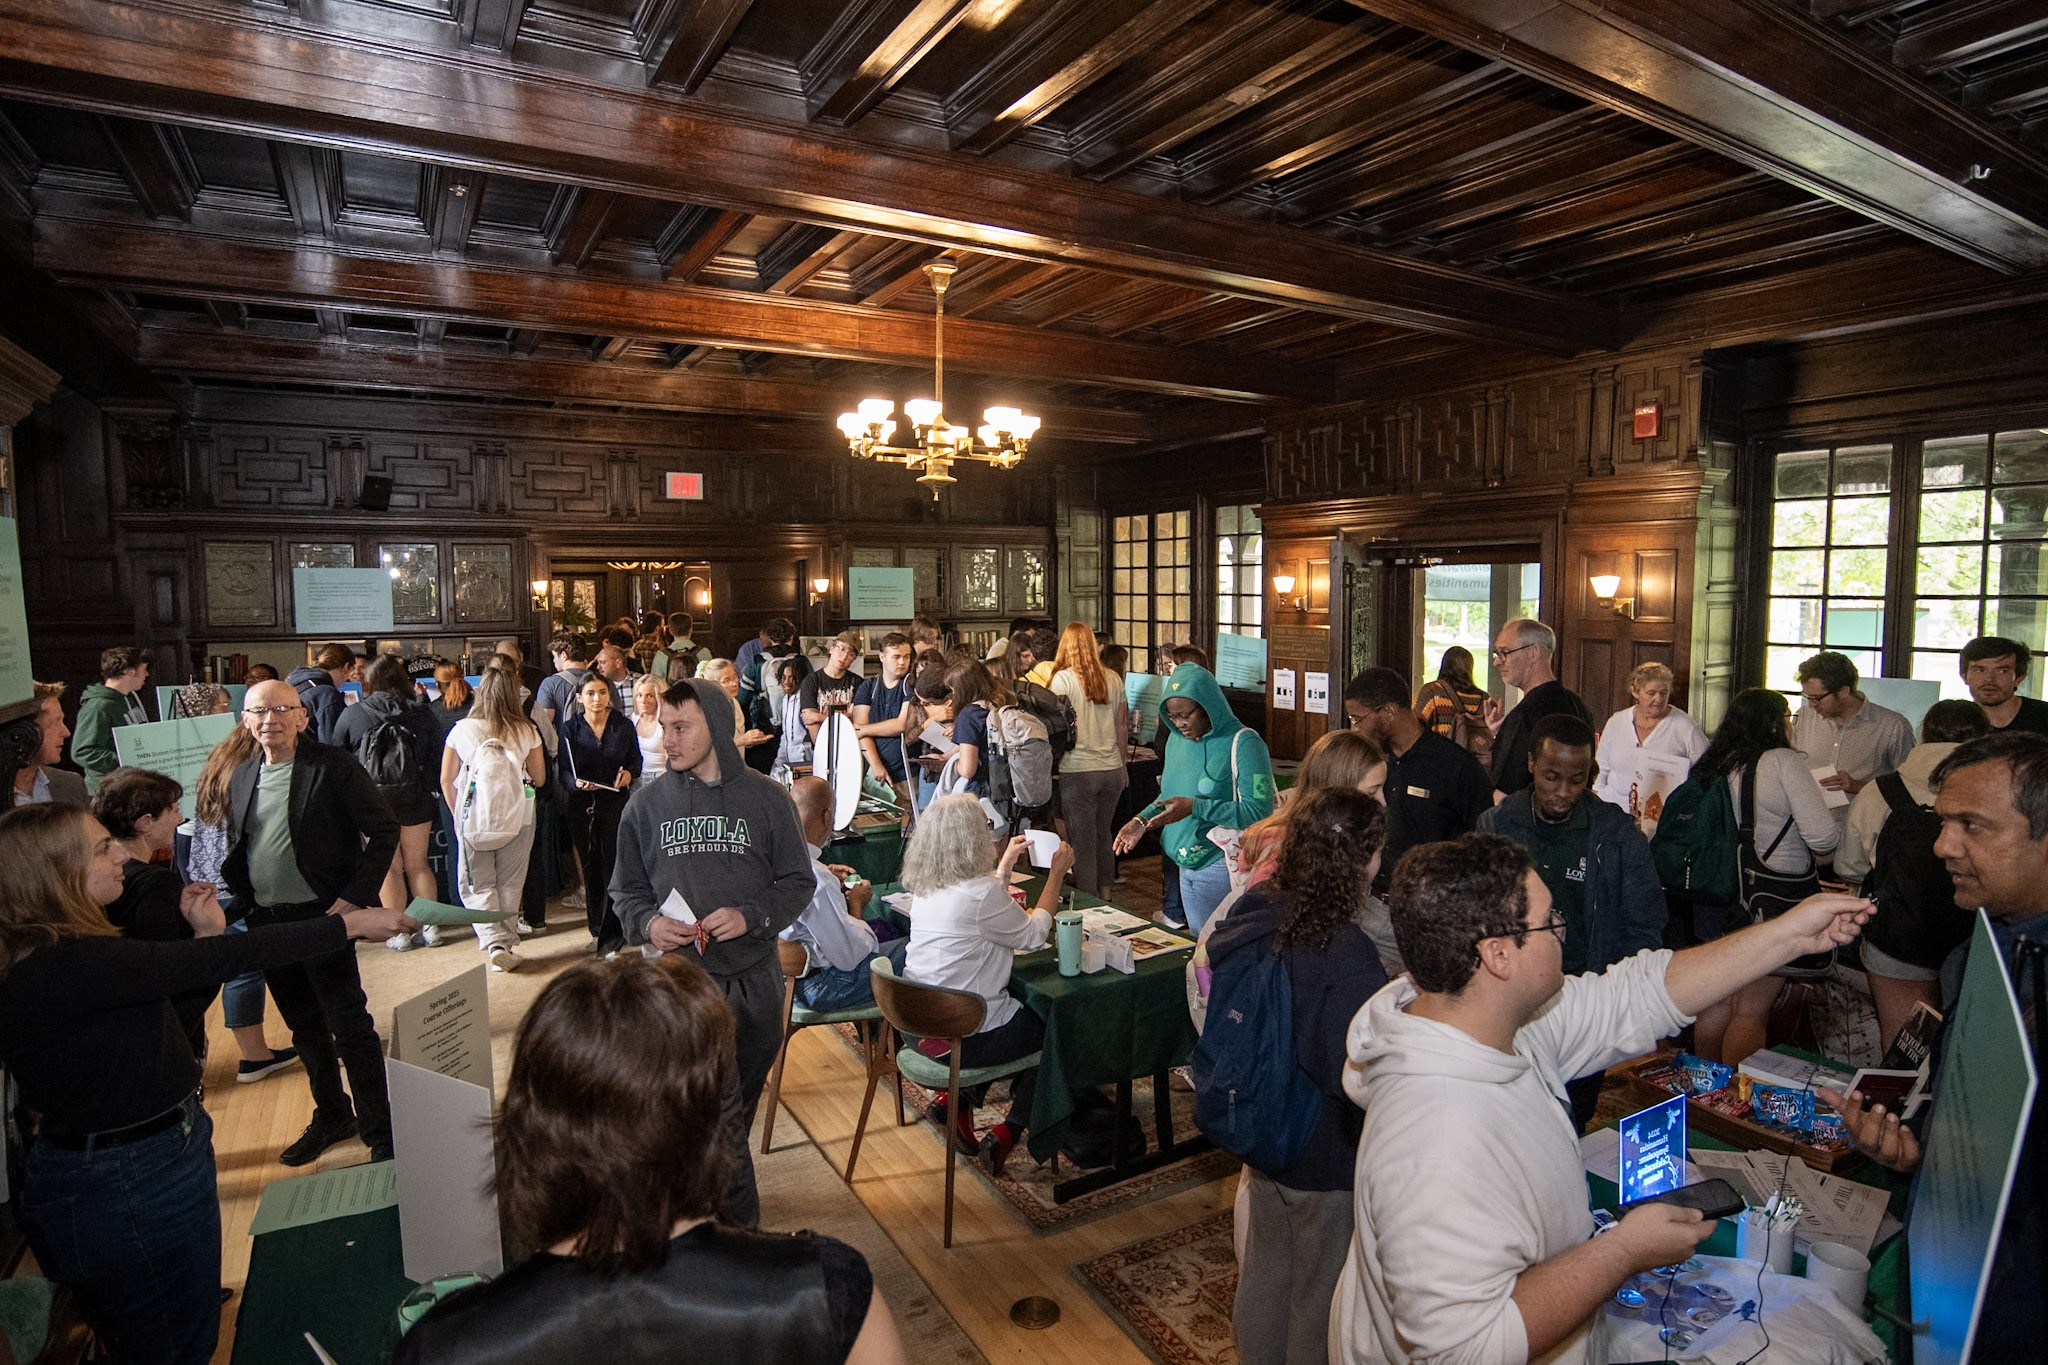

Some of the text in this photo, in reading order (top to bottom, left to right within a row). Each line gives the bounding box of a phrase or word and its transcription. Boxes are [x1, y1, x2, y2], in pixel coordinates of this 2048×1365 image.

[671, 474, 699, 497] EXIT
[136, 752, 151, 760] THEN
[661, 815, 752, 850] LOYOLA
[667, 843, 745, 857] GREYHOUNDS
[423, 998, 467, 1025] Course Offerings
[429, 996, 448, 1010] Spring
[1897, 1037, 1919, 1064] TRUTHS
[1901, 1029, 1926, 1055] UNTOLD
